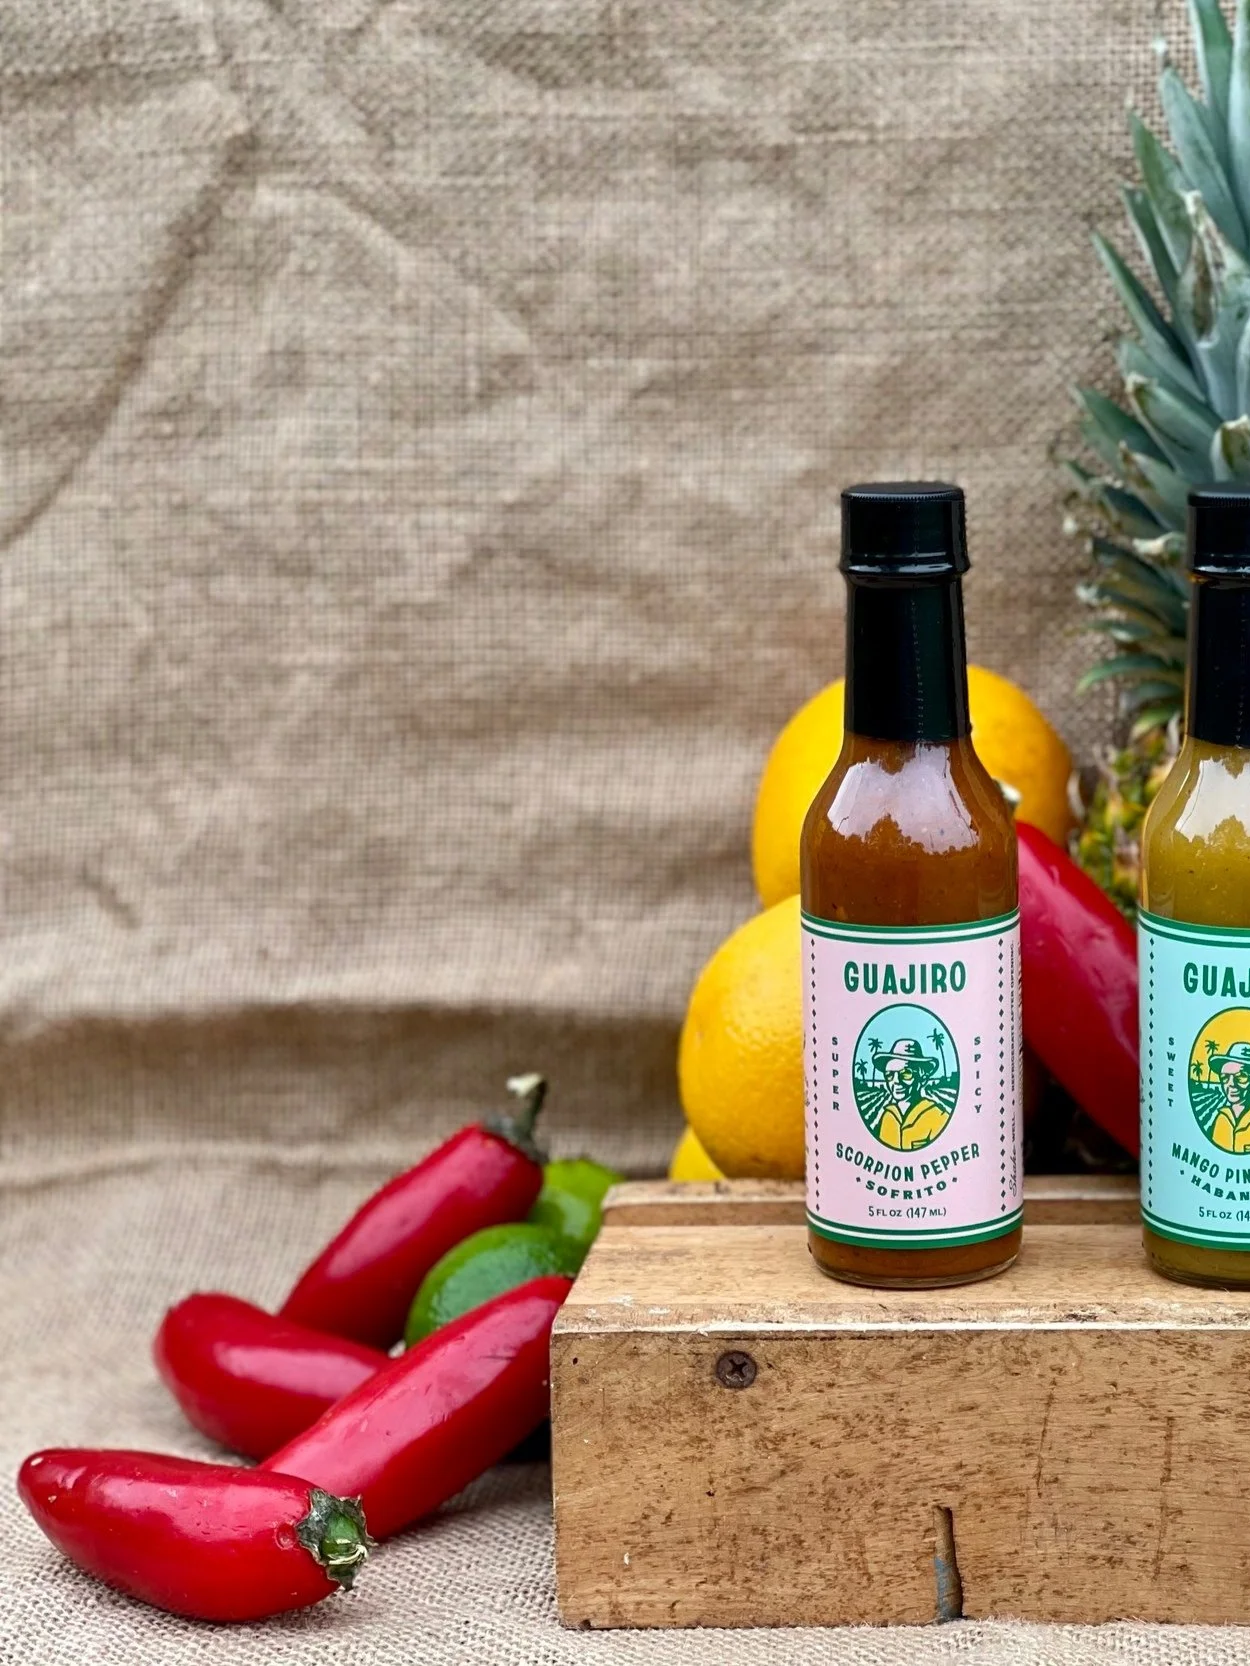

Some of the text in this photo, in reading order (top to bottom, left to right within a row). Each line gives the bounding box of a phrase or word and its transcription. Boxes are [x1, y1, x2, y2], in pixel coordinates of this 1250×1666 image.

[844, 961, 966, 995] GUAJIRO
[832, 1037, 840, 1111] SUPER
[1167, 1037, 1176, 1108] SWEET
[836, 1143, 914, 1182] SCORPION
[920, 1143, 980, 1179] PEPPER
[1171, 1143, 1220, 1178] MANGO
[866, 1180, 947, 1200] SOFRITO
[869, 1206, 947, 1219] 5 FL OZ (147 ML)
[1199, 1207, 1205, 1218] 5
[1207, 1210, 1218, 1218] FL
[1219, 1212, 1232, 1220] OZ
